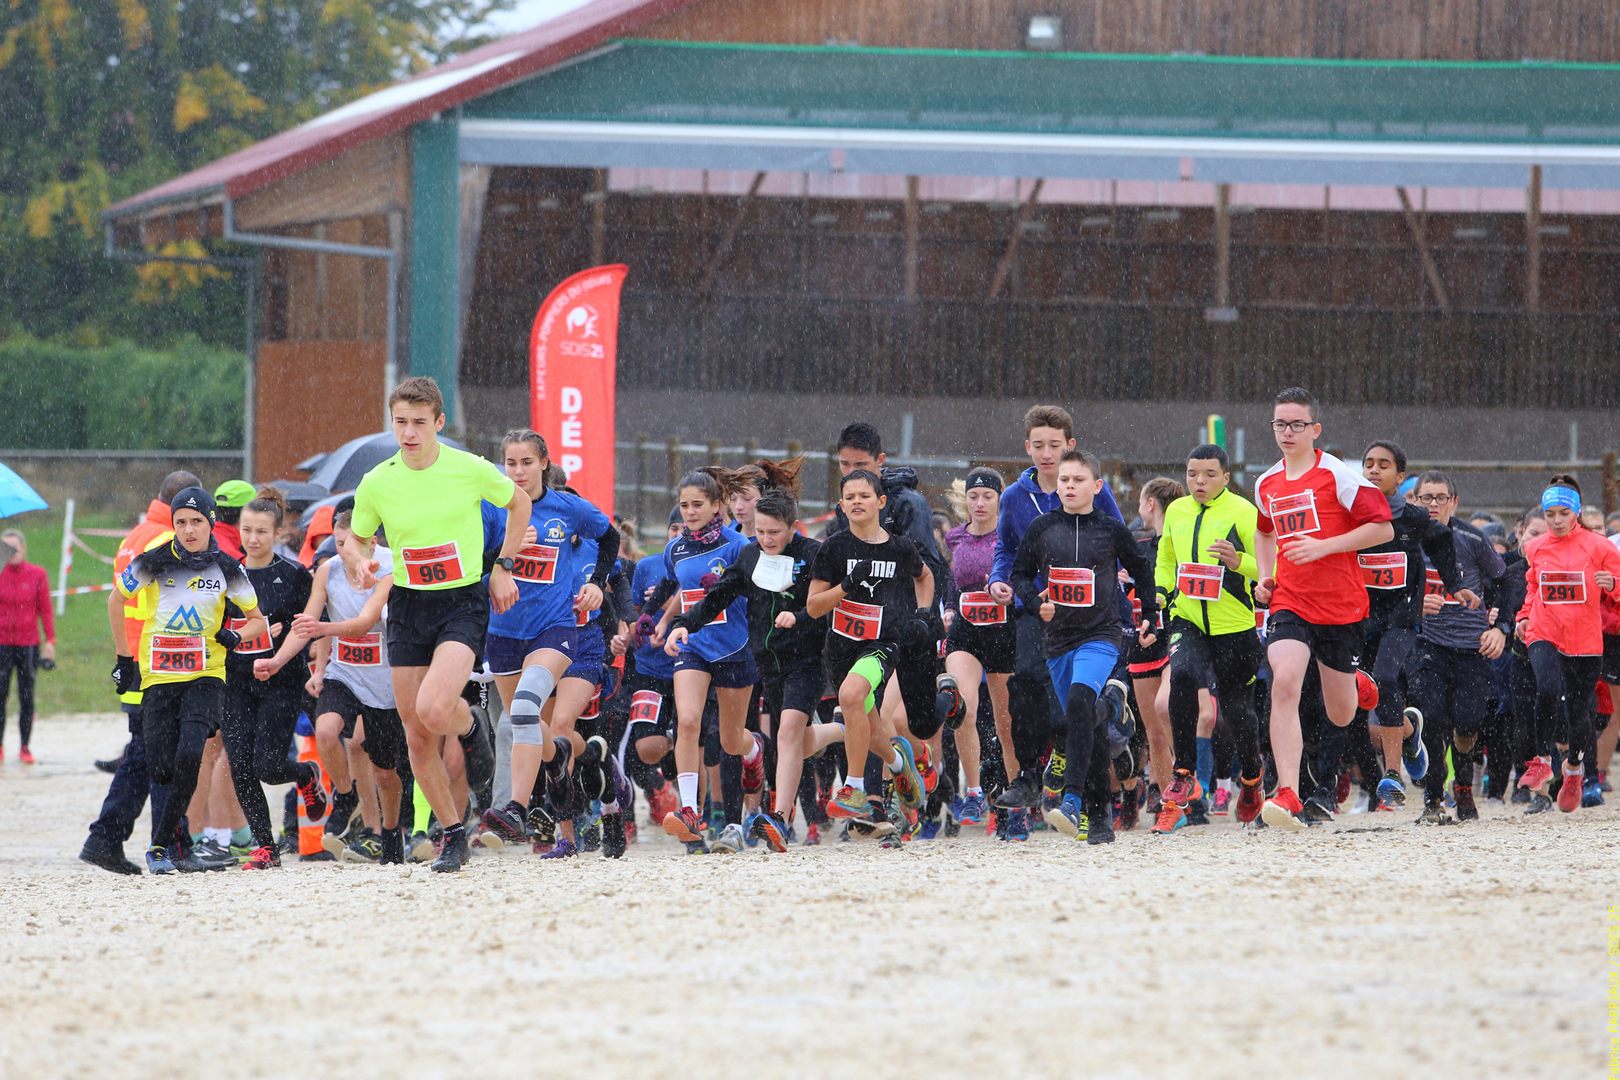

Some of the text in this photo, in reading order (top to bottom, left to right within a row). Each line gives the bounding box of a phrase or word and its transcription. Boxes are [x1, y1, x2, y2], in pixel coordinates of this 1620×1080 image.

[1279, 512, 1306, 532] 107
[419, 563, 447, 582] 96
[513, 560, 547, 578] 207
[847, 559, 896, 578] PMA
[1371, 569, 1394, 585] 73
[198, 579, 220, 590] DSA
[1052, 584, 1085, 602] 186
[1188, 579, 1205, 595] 11
[1547, 586, 1575, 600] 291
[967, 607, 998, 621] 464
[844, 617, 865, 637] 76
[159, 652, 196, 670] 286
[343, 646, 373, 662] 298
